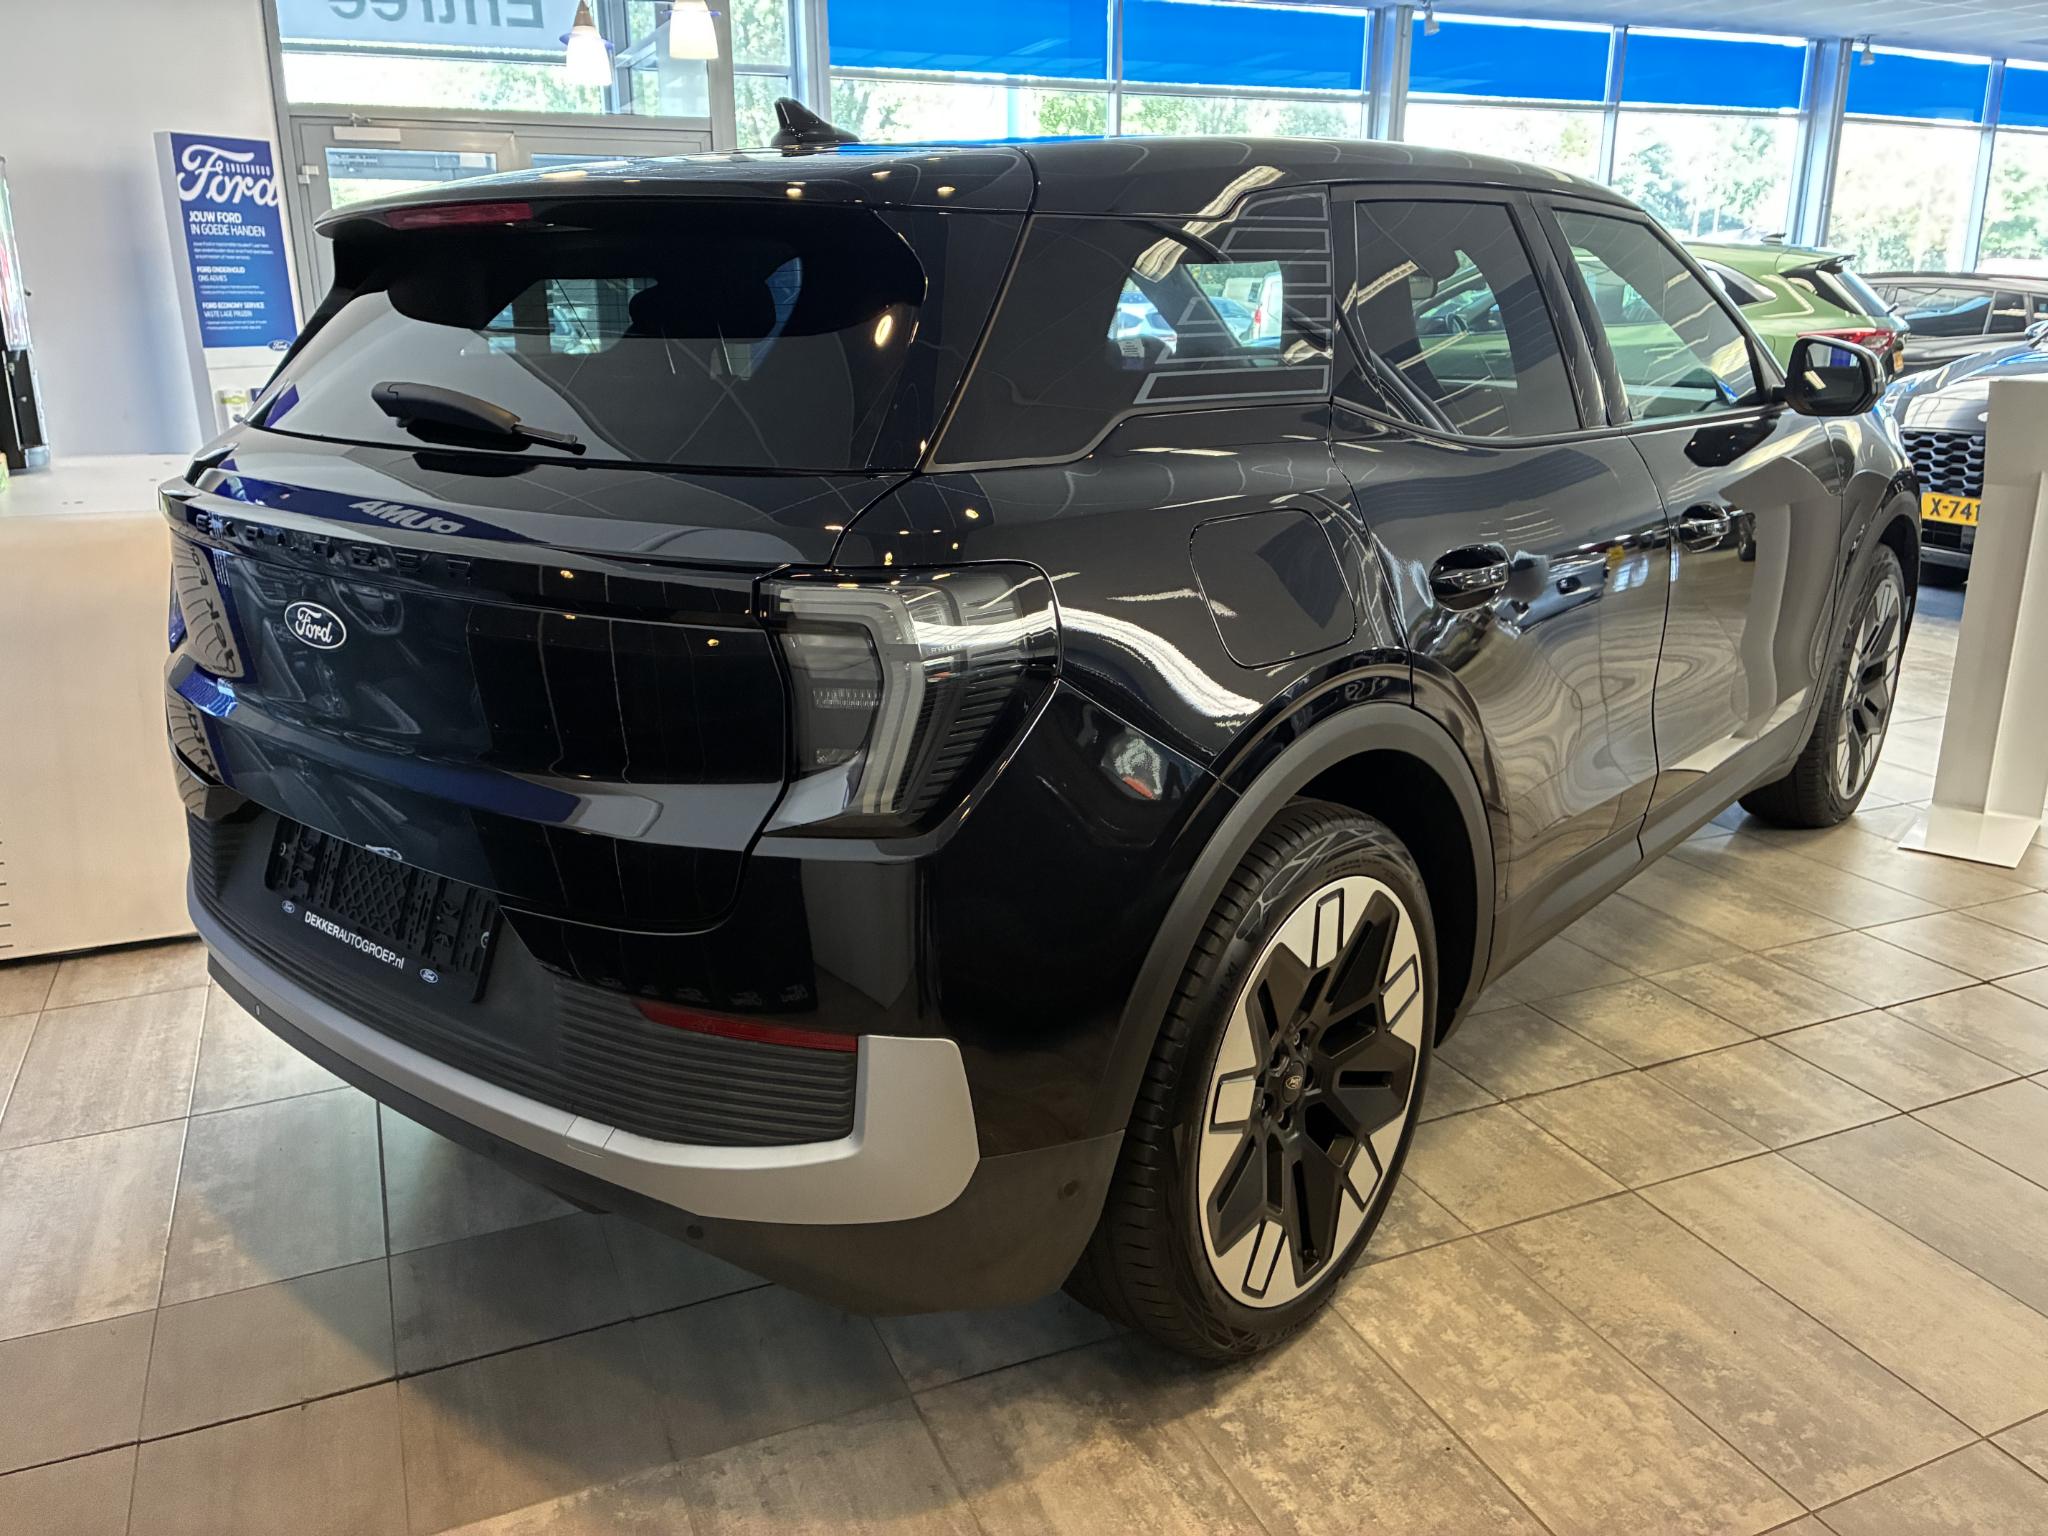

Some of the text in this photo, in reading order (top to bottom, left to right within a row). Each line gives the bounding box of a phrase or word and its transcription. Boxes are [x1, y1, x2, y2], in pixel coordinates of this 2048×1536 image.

[177, 144, 278, 206] Ford
[189, 211, 242, 224] JOUW FORD
[191, 224, 266, 237] IN GOEDE HANDEN
[304, 911, 405, 970] DEKKERAUTOGROEP.nl
